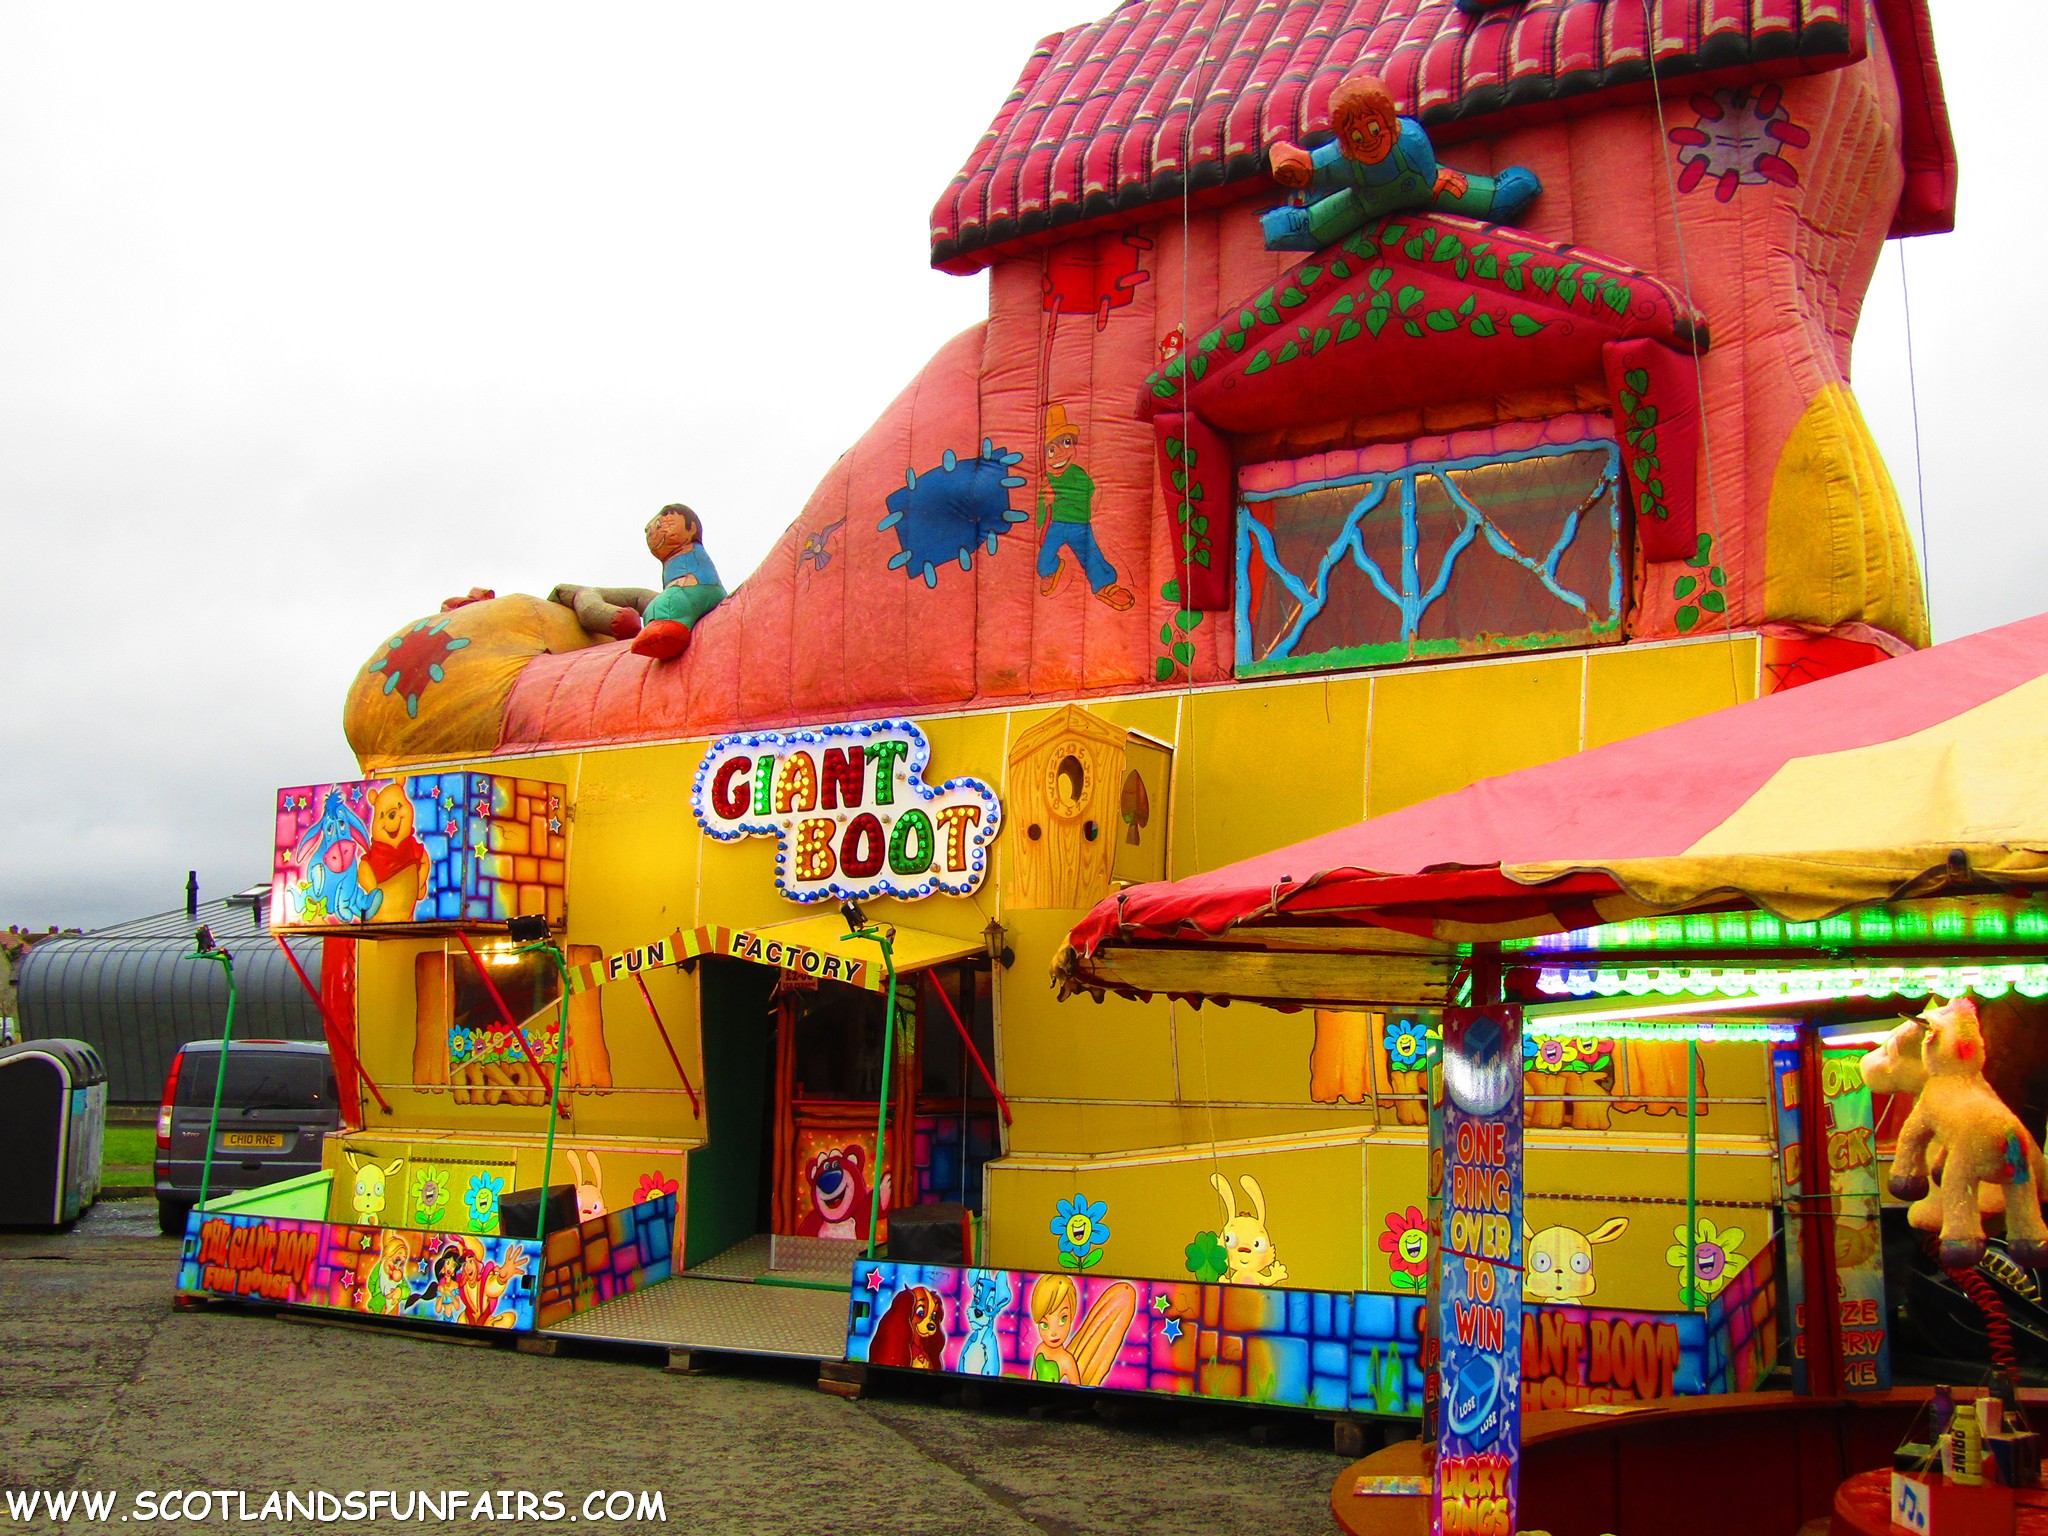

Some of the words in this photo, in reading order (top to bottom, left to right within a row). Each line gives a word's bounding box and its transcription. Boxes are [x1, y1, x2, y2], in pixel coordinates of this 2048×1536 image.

[711, 740, 909, 820] GIANT
[796, 804, 982, 882] BOOT
[609, 941, 665, 979] FUN
[732, 934, 861, 982] FACTORY
[255, 1135, 276, 1144] RNE
[1456, 1121, 1507, 1167] ONE
[1452, 1164, 1511, 1215] RING
[199, 1218, 232, 1266] THE
[228, 1224, 278, 1274] GIANT
[273, 1229, 318, 1298] BOOT
[1451, 1210, 1512, 1261] OVER
[202, 1265, 237, 1293] FUN
[236, 1266, 292, 1299] HOUSE
[1463, 1257, 1496, 1303] TO
[1454, 1300, 1503, 1354] WIN
[1521, 1312, 1584, 1385] ANT
[1589, 1319, 1680, 1400] BOOT
[1459, 1395, 1476, 1419] LOSE
[1480, 1411, 1497, 1434] LOSE
[1440, 1454, 1511, 1499] LUCKY
[1441, 1497, 1510, 1536] RINGS
